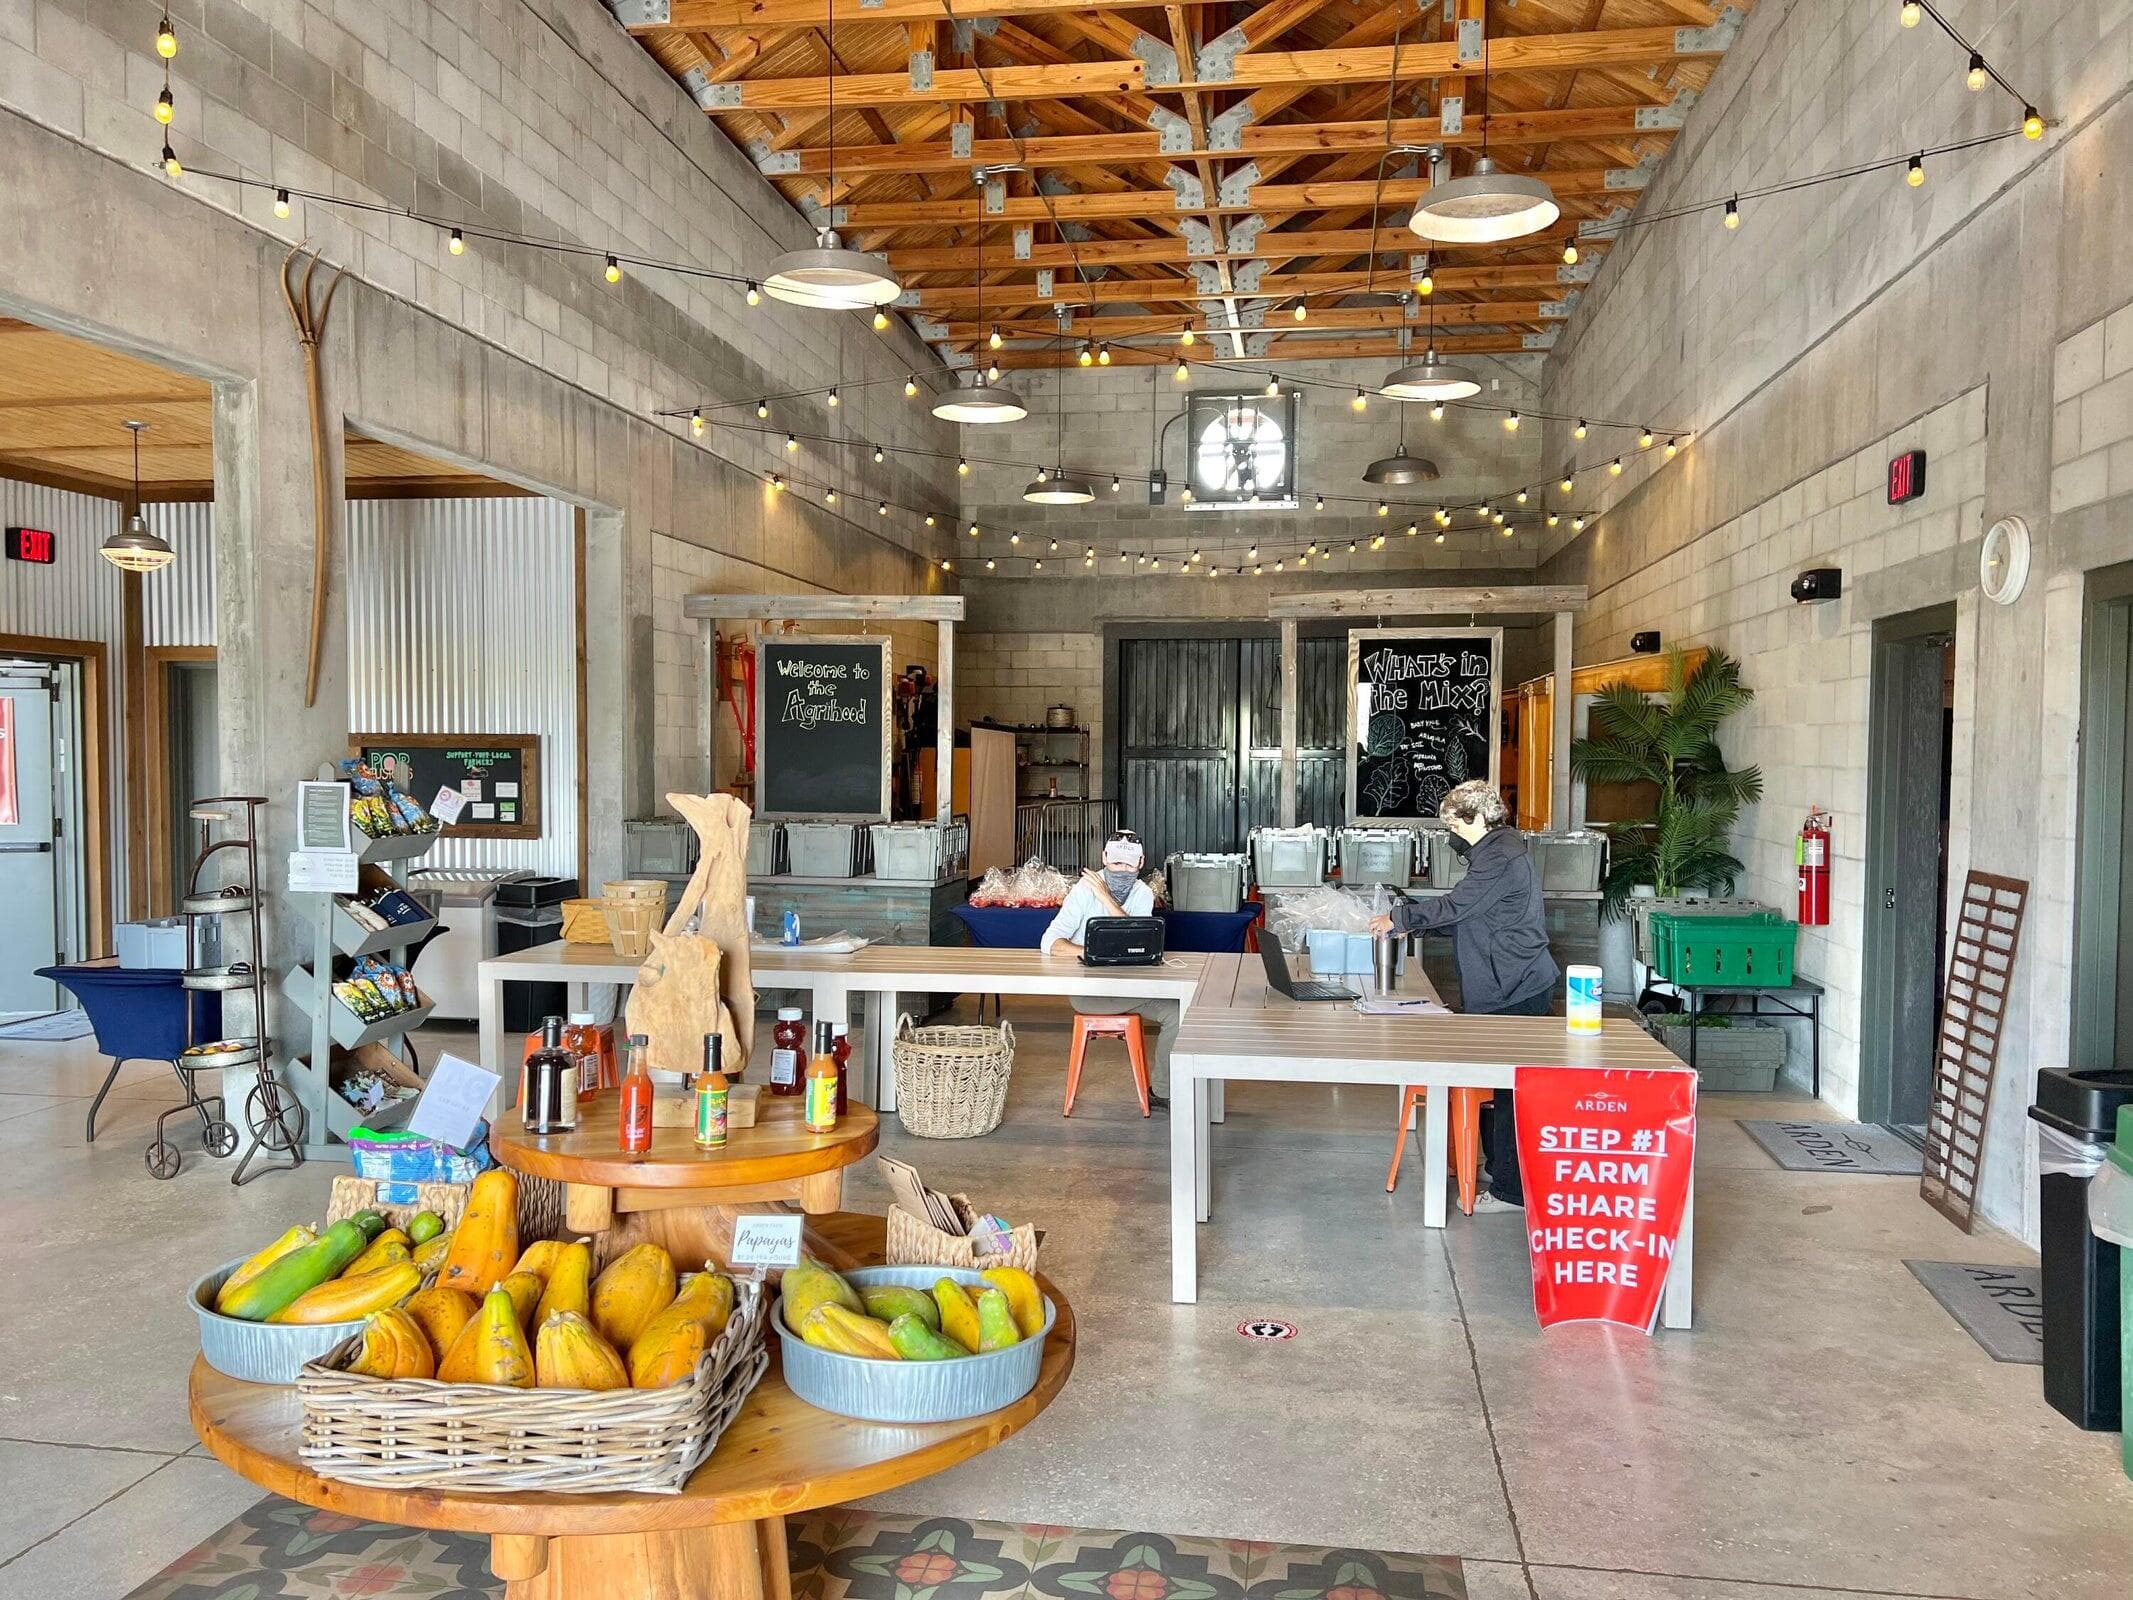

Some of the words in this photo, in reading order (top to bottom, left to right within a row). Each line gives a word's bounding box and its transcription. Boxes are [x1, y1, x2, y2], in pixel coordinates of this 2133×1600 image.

[1891, 453, 1912, 500] EXIT
[777, 659, 847, 679] Welcome
[853, 662, 870, 680] to
[1460, 651, 1489, 677] in
[808, 680, 837, 697] the
[1370, 683, 1408, 716] the
[781, 688, 867, 730] Agrihood
[491, 751, 512, 759] LOCAL
[1574, 1100, 1628, 1113] ARDEN
[1539, 1125, 1620, 1150] STEP
[1631, 1129, 1667, 1153] #1
[1775, 1122, 1861, 1169] ARDEN
[1555, 1160, 1649, 1186] FARM
[1547, 1194, 1657, 1221] SHARE
[737, 1229, 796, 1254] Papayas
[1530, 1227, 1675, 1259] CHECK-IN
[1554, 1261, 1639, 1288] HERE
